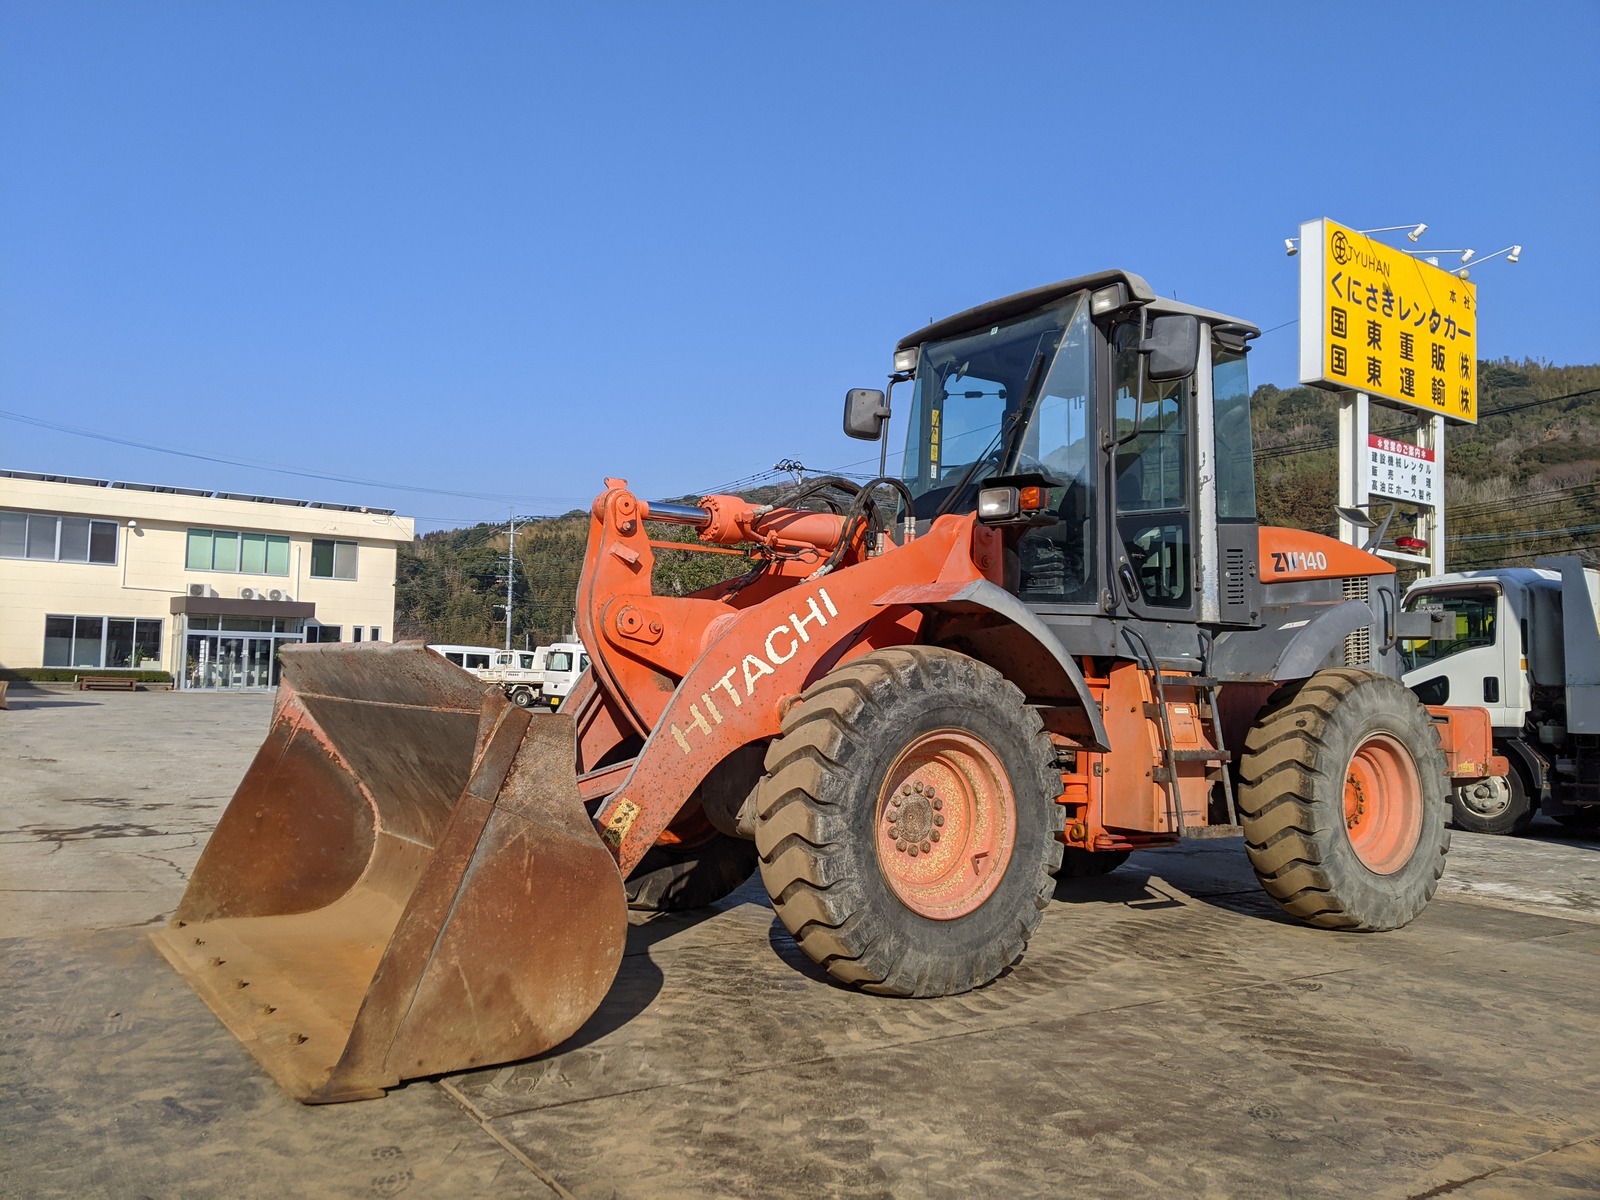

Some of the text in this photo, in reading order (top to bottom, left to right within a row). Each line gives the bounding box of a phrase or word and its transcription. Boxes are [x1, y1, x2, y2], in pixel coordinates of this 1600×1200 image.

[1346, 245, 1390, 277] JYUHAN
[1331, 271, 1471, 340] くにさきレンタカー
[670, 588, 839, 755] HITACHI
